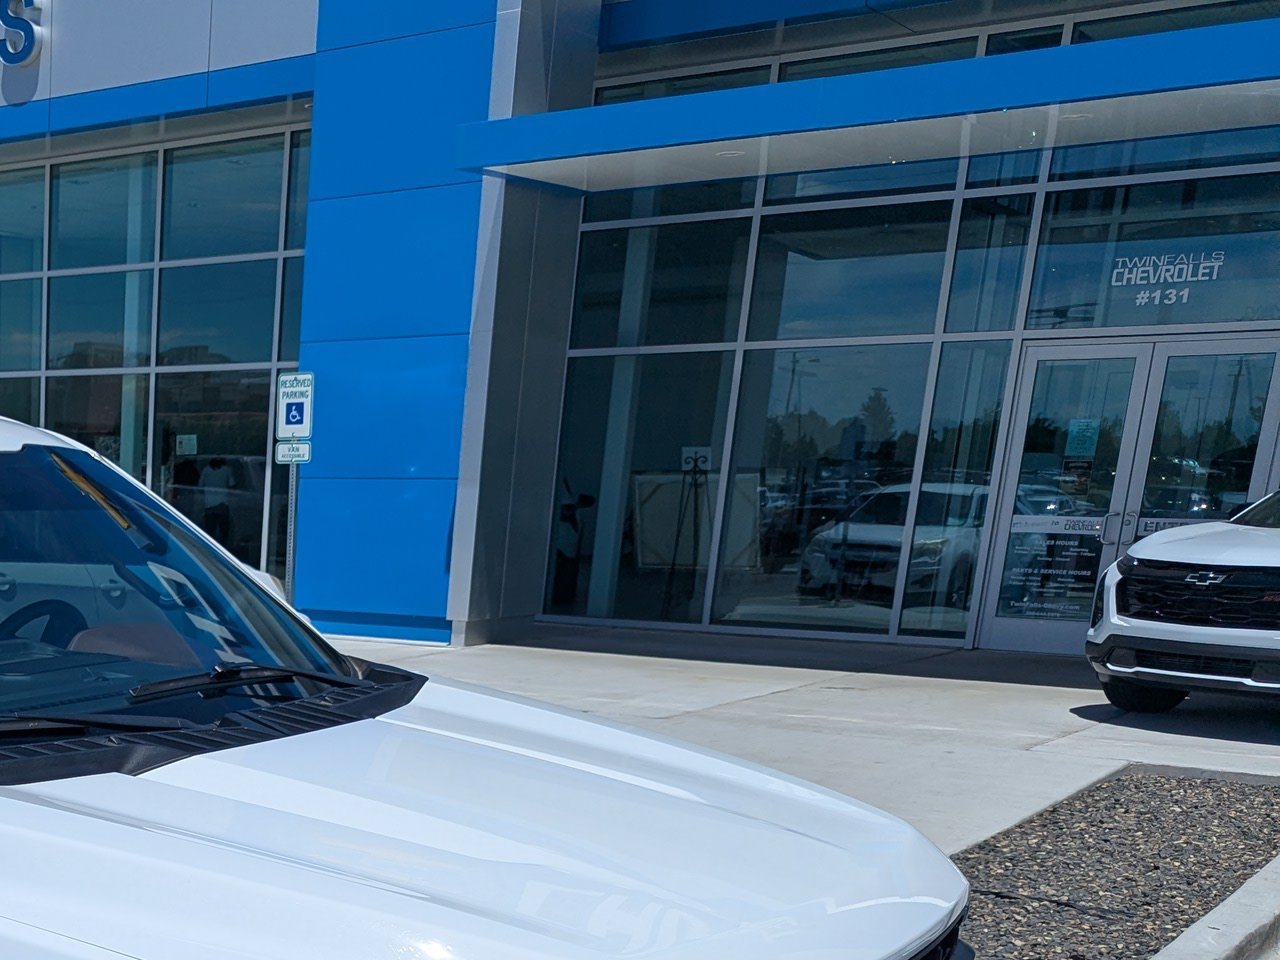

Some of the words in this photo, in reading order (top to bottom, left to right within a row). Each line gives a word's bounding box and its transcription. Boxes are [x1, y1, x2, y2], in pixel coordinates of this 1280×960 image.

[1115, 251, 1225, 269] TWINFALLS
[1111, 261, 1224, 286] CHEVROLET
[1135, 287, 1190, 306] #131
[280, 379, 311, 388] RESERVED
[282, 390, 309, 400] PARKING
